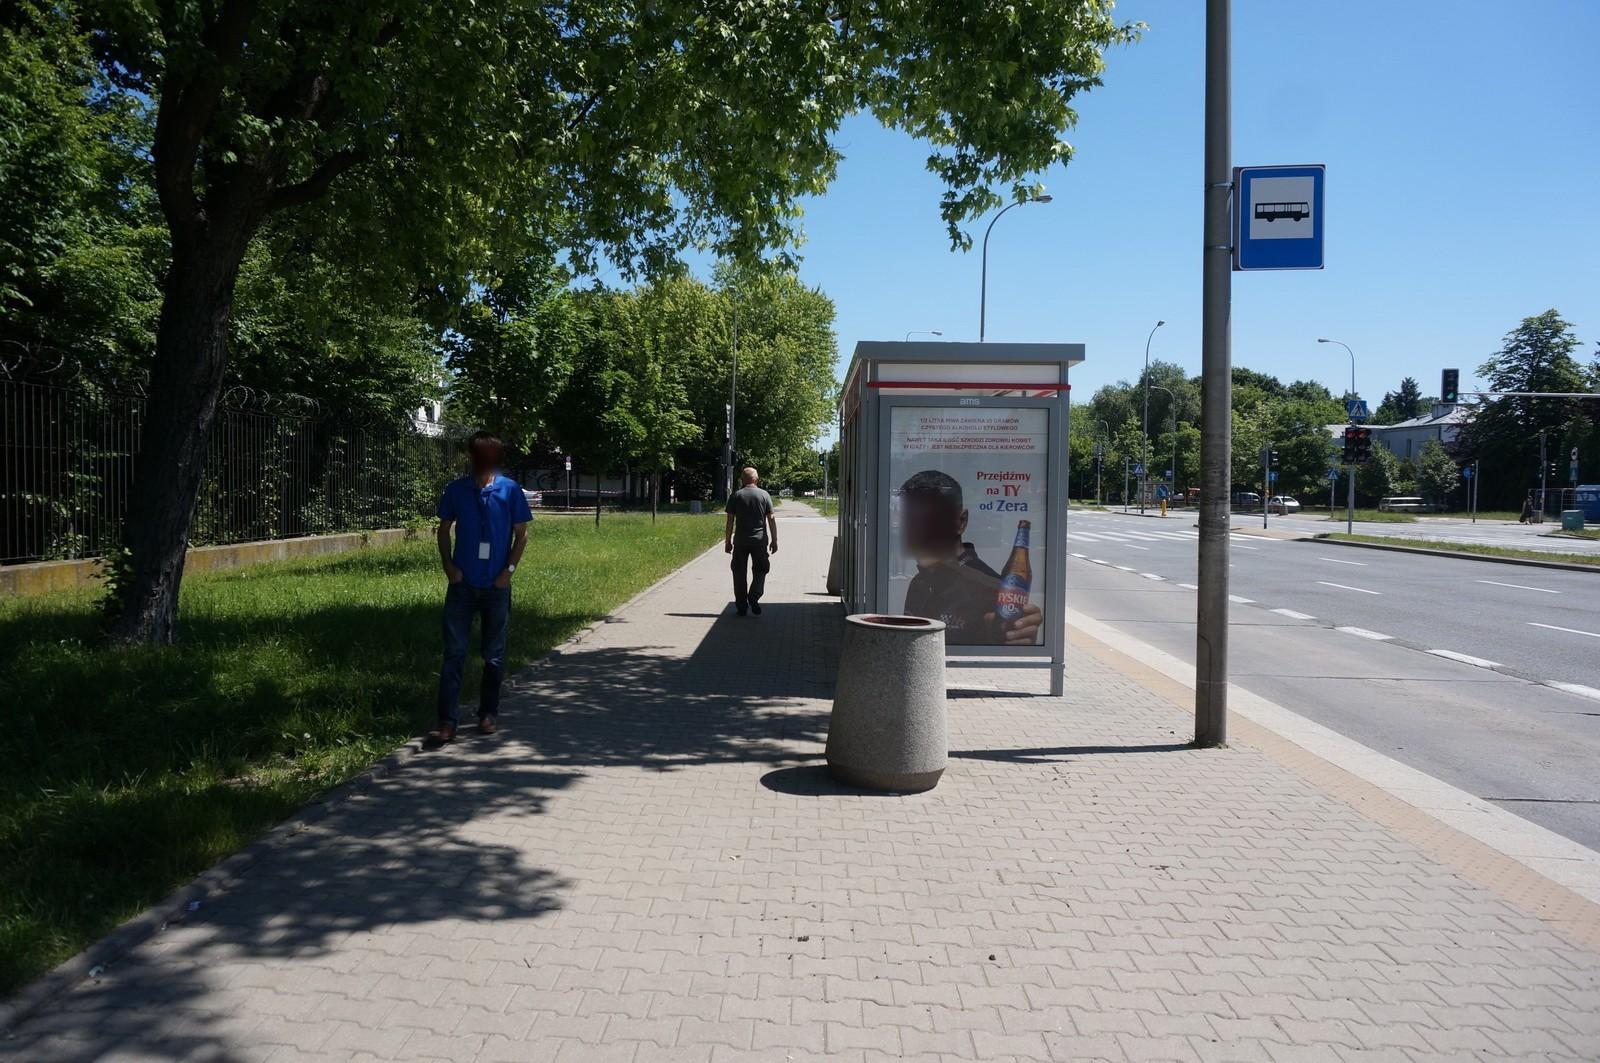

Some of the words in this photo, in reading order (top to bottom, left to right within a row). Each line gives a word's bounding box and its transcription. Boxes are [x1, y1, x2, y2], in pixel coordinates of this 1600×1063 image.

[960, 398, 980, 406] ams
[976, 471, 1031, 482] Przejdźmy
[986, 487, 999, 495] na
[1002, 484, 1021, 497] TY
[979, 501, 993, 511] od
[996, 499, 1028, 512] Zera
